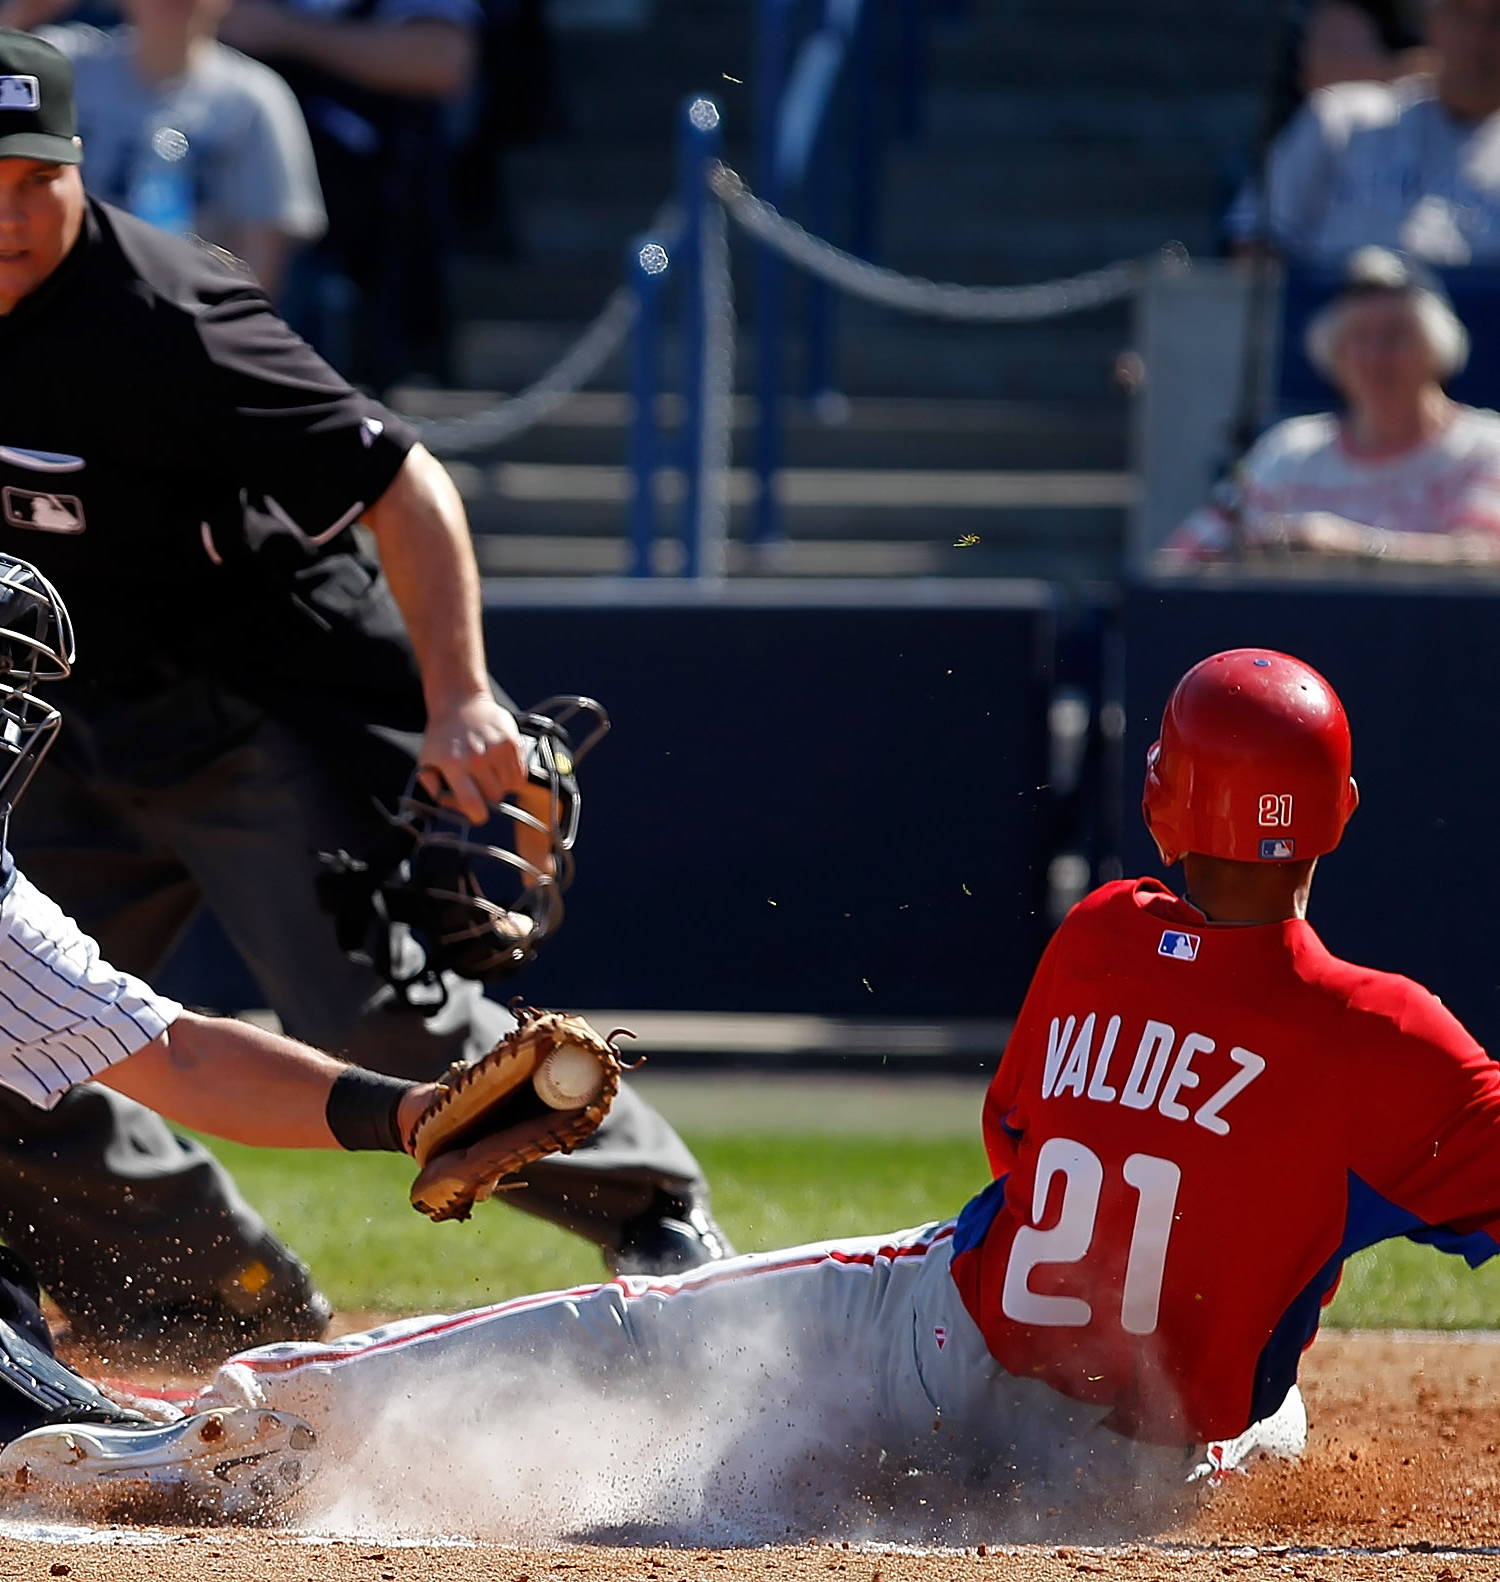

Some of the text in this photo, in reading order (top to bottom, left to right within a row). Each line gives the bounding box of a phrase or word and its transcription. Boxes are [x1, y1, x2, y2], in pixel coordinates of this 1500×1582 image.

[1258, 793, 1293, 827] 21
[1041, 1011, 1266, 1136] VALDEZ
[1002, 1137, 1181, 1336] 21
